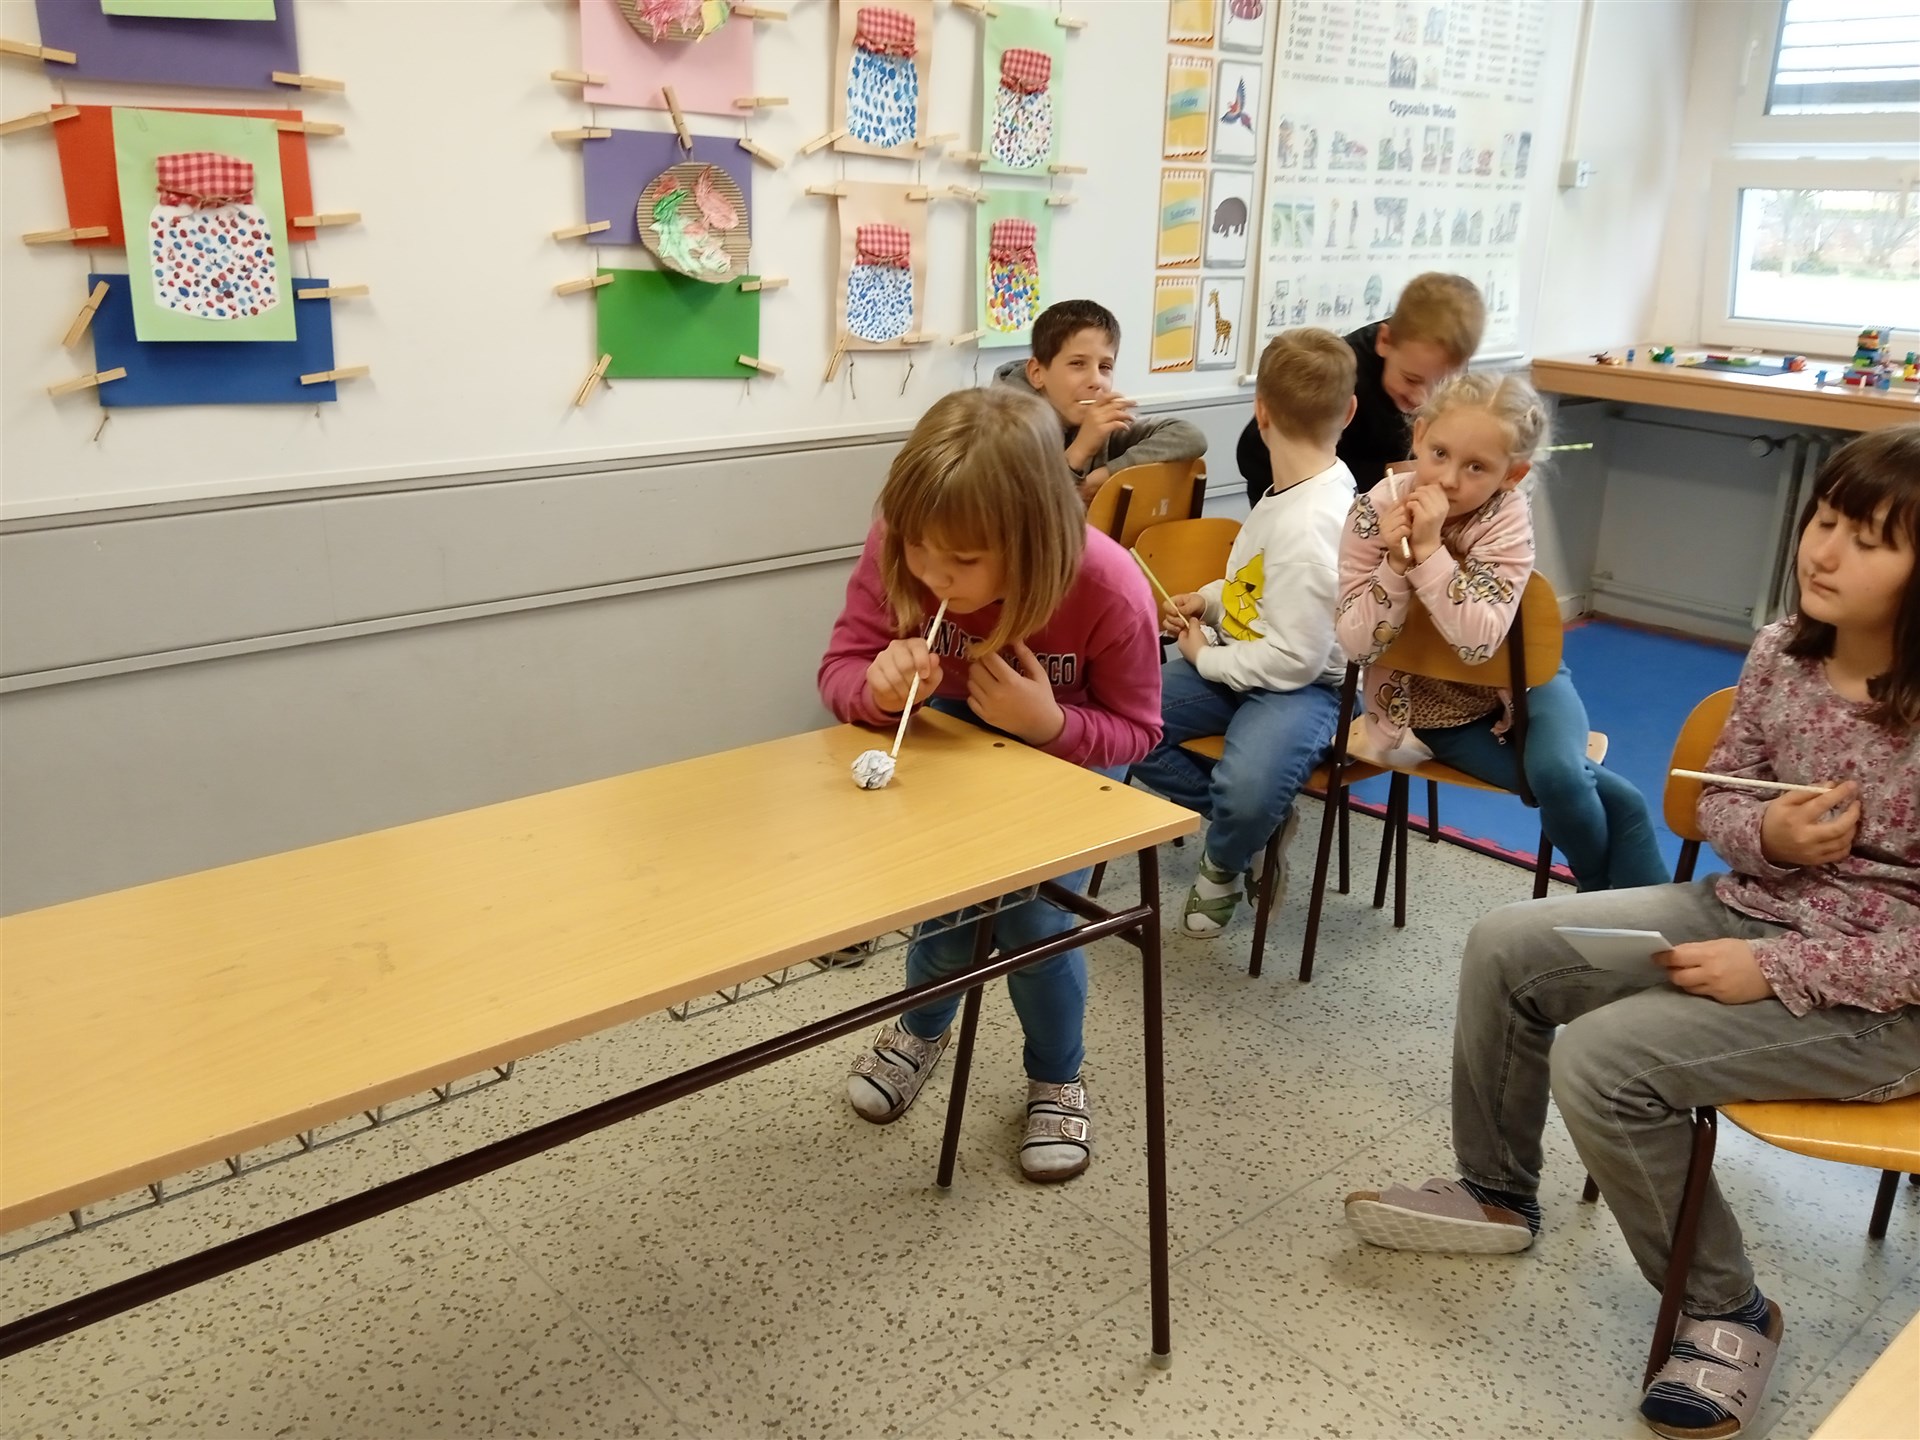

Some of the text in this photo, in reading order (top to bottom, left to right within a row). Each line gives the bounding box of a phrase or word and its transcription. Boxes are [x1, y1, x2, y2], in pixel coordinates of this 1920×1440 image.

[1389, 99, 1456, 119] Opposite Words
[918, 616, 956, 658] AN
